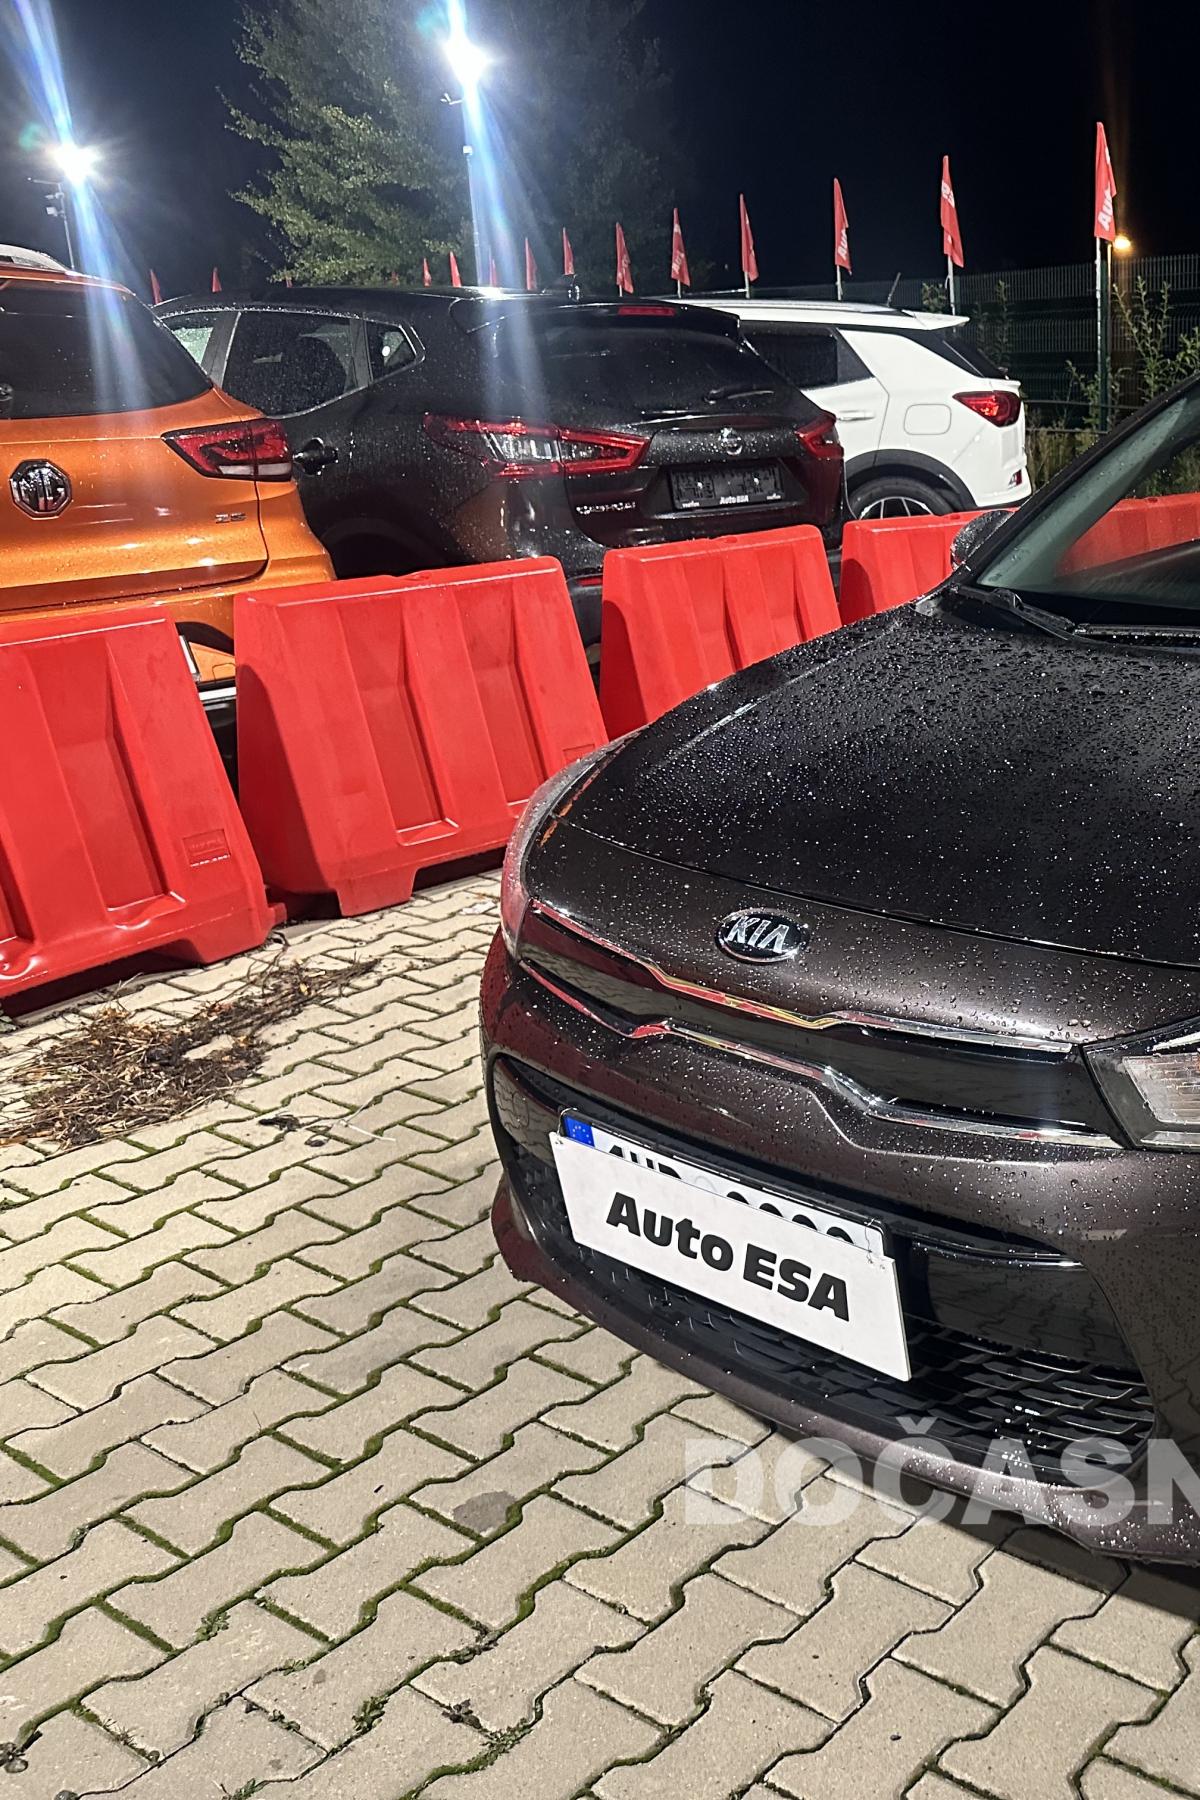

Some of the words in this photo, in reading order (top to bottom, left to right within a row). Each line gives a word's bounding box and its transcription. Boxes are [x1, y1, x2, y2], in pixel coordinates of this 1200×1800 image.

[724, 915, 790, 954] KIA
[606, 1191, 734, 1272] Auto
[743, 1243, 850, 1322] ESA
